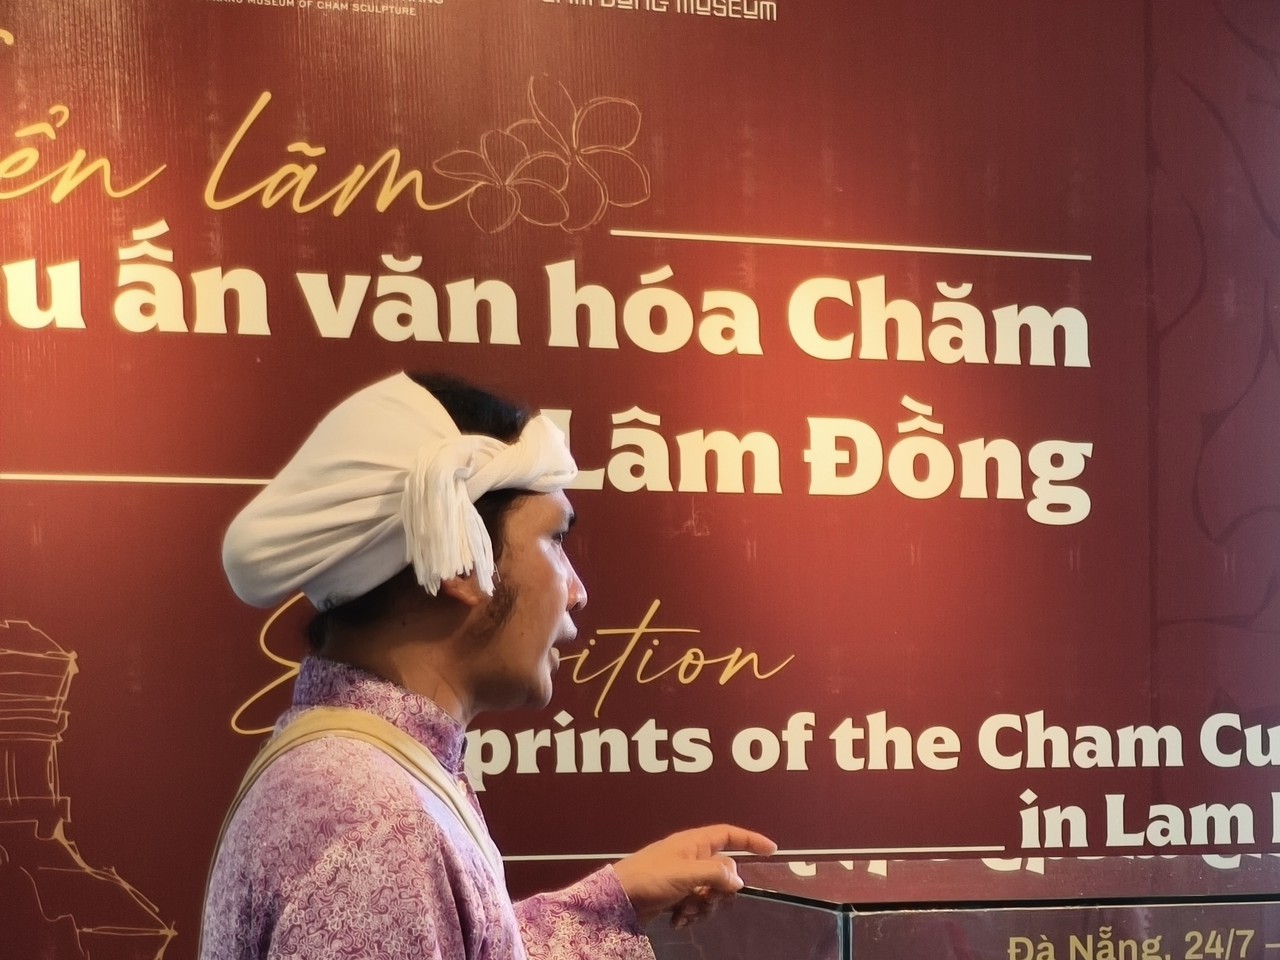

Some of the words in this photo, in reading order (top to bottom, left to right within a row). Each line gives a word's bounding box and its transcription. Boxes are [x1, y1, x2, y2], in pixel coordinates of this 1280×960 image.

[299, 0, 314, 8] OF
[317, 1, 349, 11] CHAM
[352, 3, 417, 16] SCULPTURE
[204, 91, 485, 217] lãm
[112, 219, 272, 336] ấn
[296, 254, 521, 345] văn
[545, 259, 764, 356] hóa
[787, 275, 1092, 368] Chăm
[803, 394, 1094, 526] Đồng
[464, 710, 714, 792] prints
[731, 711, 815, 773] of
[829, 711, 961, 772] the
[978, 709, 1184, 770] Cham
[1019, 788, 1089, 849] in
[1104, 794, 1256, 847] Lam
